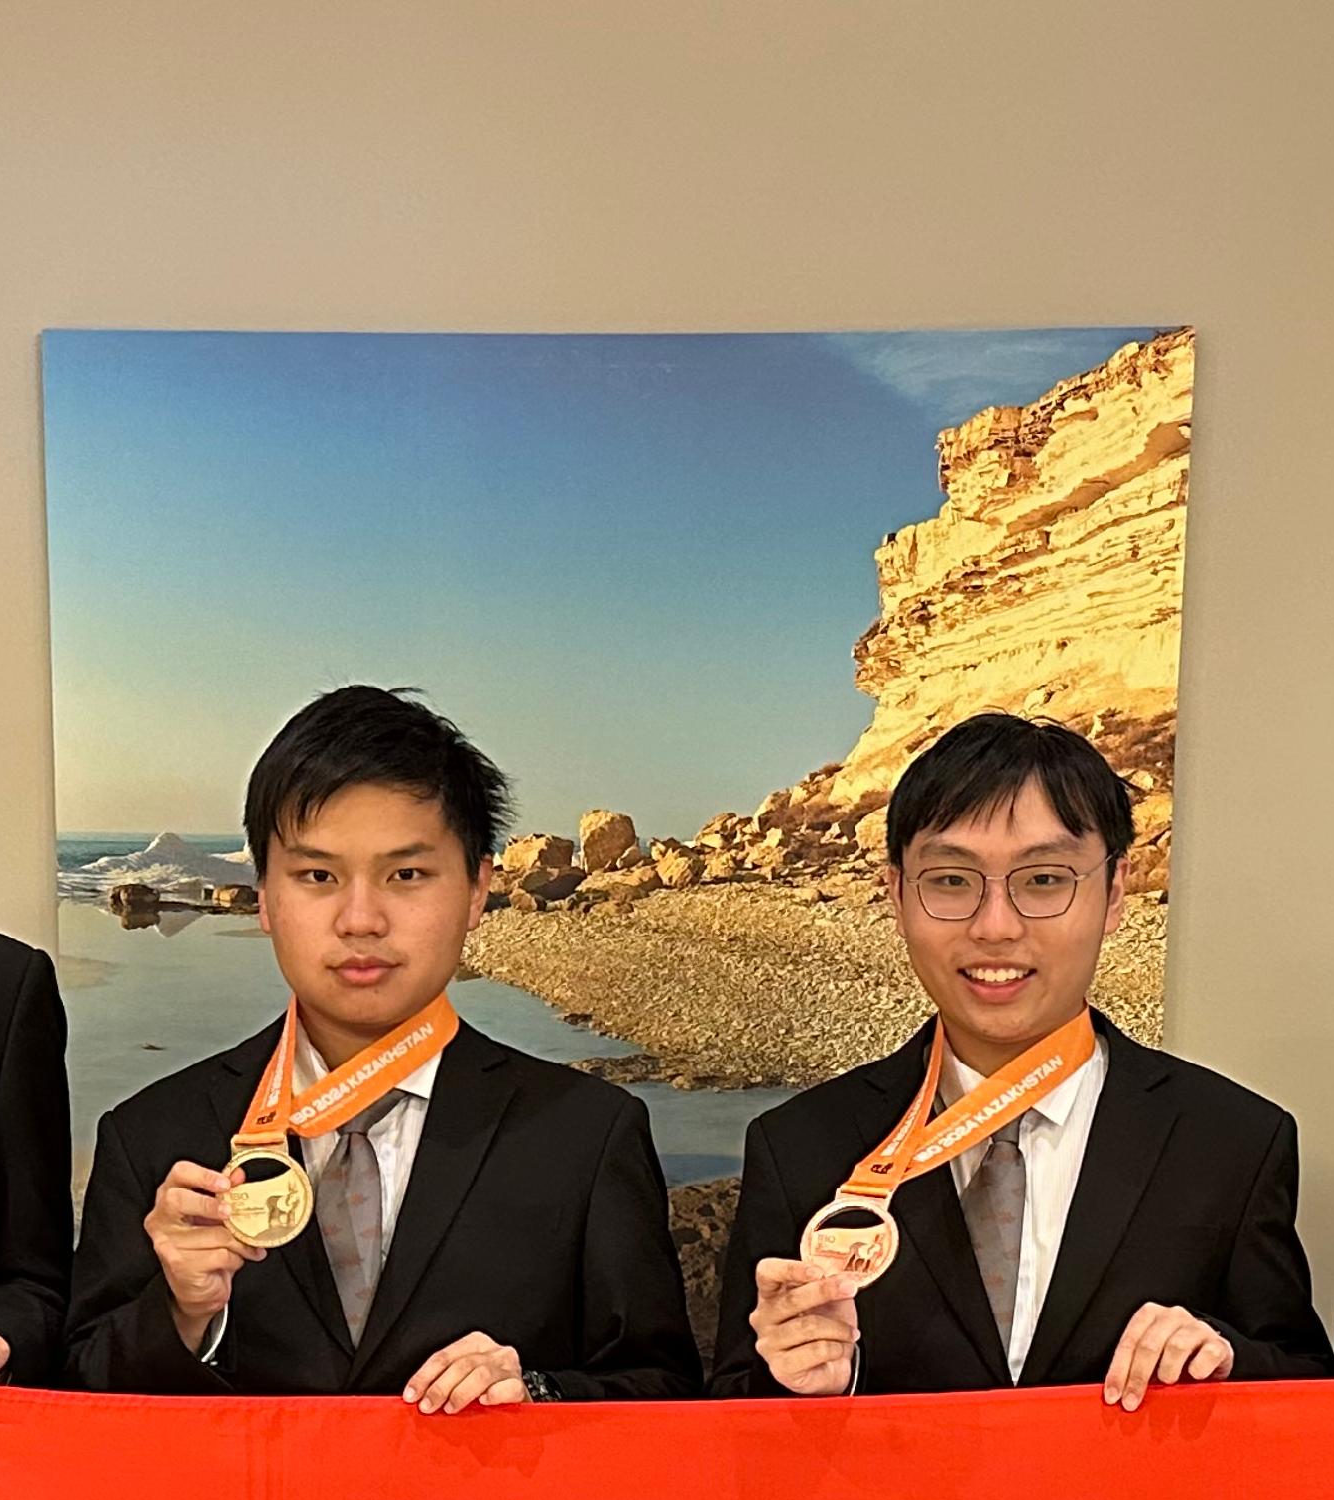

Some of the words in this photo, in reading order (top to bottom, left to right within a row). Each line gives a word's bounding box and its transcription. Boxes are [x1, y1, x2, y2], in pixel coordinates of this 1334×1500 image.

[313, 1082, 351, 1108] 2024
[347, 1022, 434, 1089] KAZAKHSTAN
[938, 1117, 975, 1147] 2024
[971, 1055, 1064, 1125] KAZAKHSTAN
